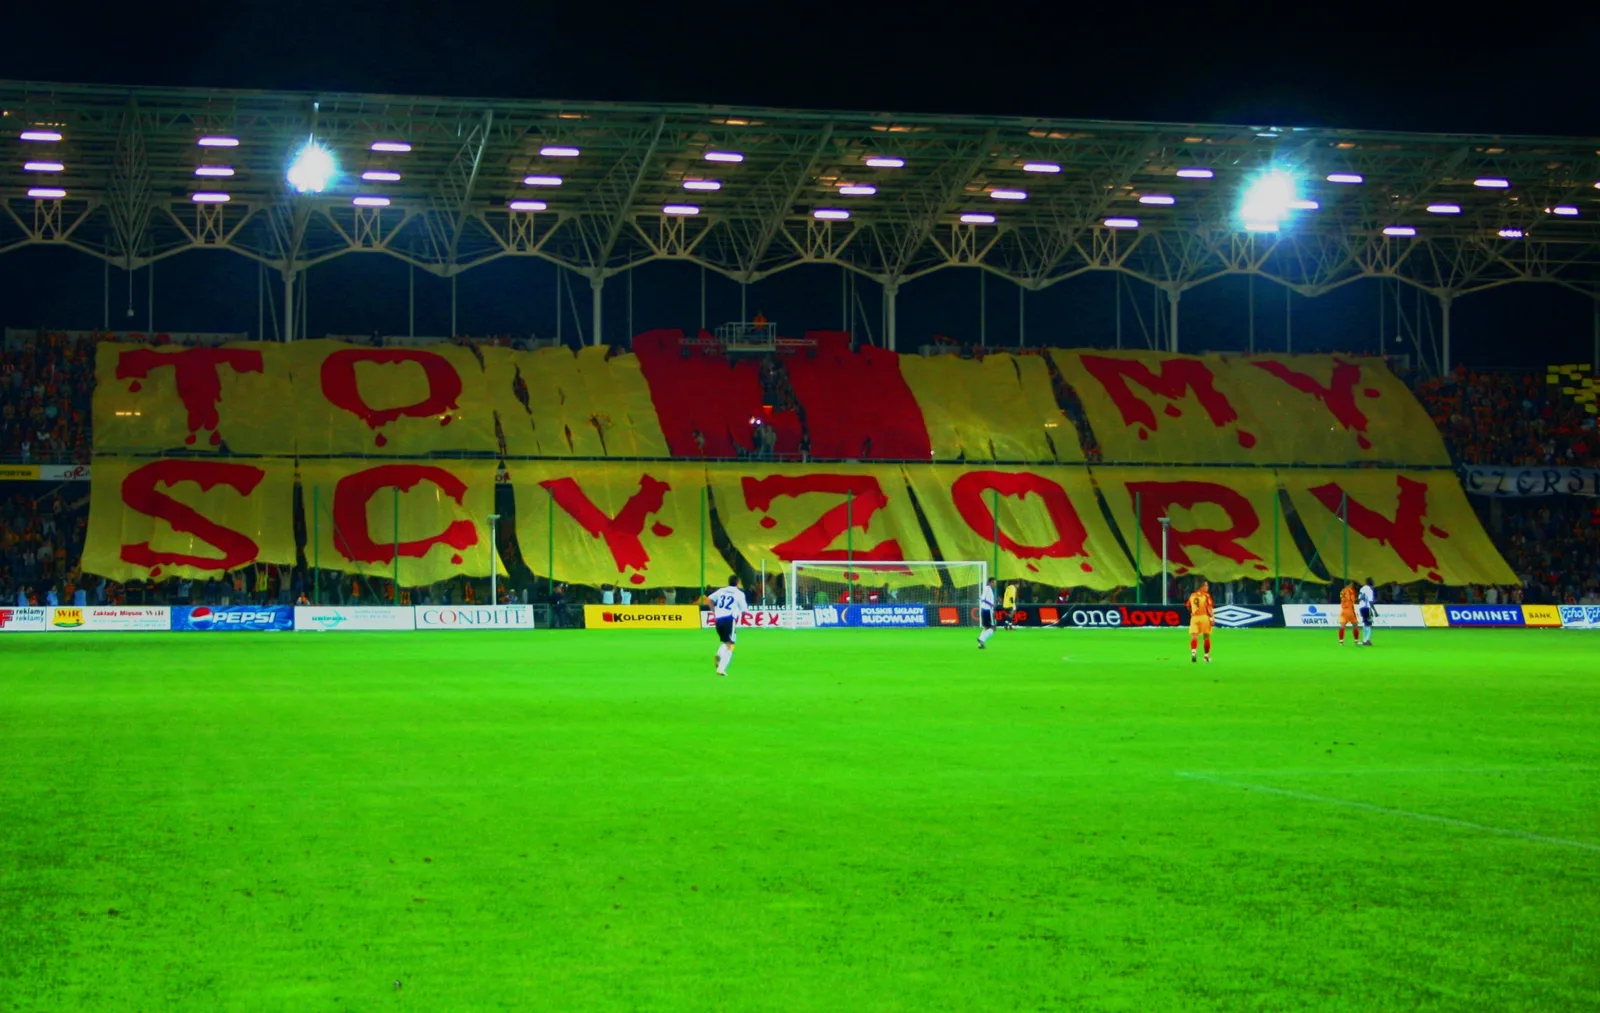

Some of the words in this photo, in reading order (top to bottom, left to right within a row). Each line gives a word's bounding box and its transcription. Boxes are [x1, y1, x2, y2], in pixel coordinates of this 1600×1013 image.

[116, 347, 462, 447] TO
[1080, 354, 1381, 449] MY
[719, 595, 735, 610] 32
[16, 608, 45, 616] reklamy
[860, 607, 892, 615] POLSKIE
[1450, 610, 1518, 621] DOMINET
[211, 611, 276, 624] PEPSI
[423, 609, 528, 625] CONDITE
[613, 612, 683, 622] KOLPORTER
[861, 614, 925, 624] BUDOWLANE
[1301, 617, 1329, 625] WARTA
